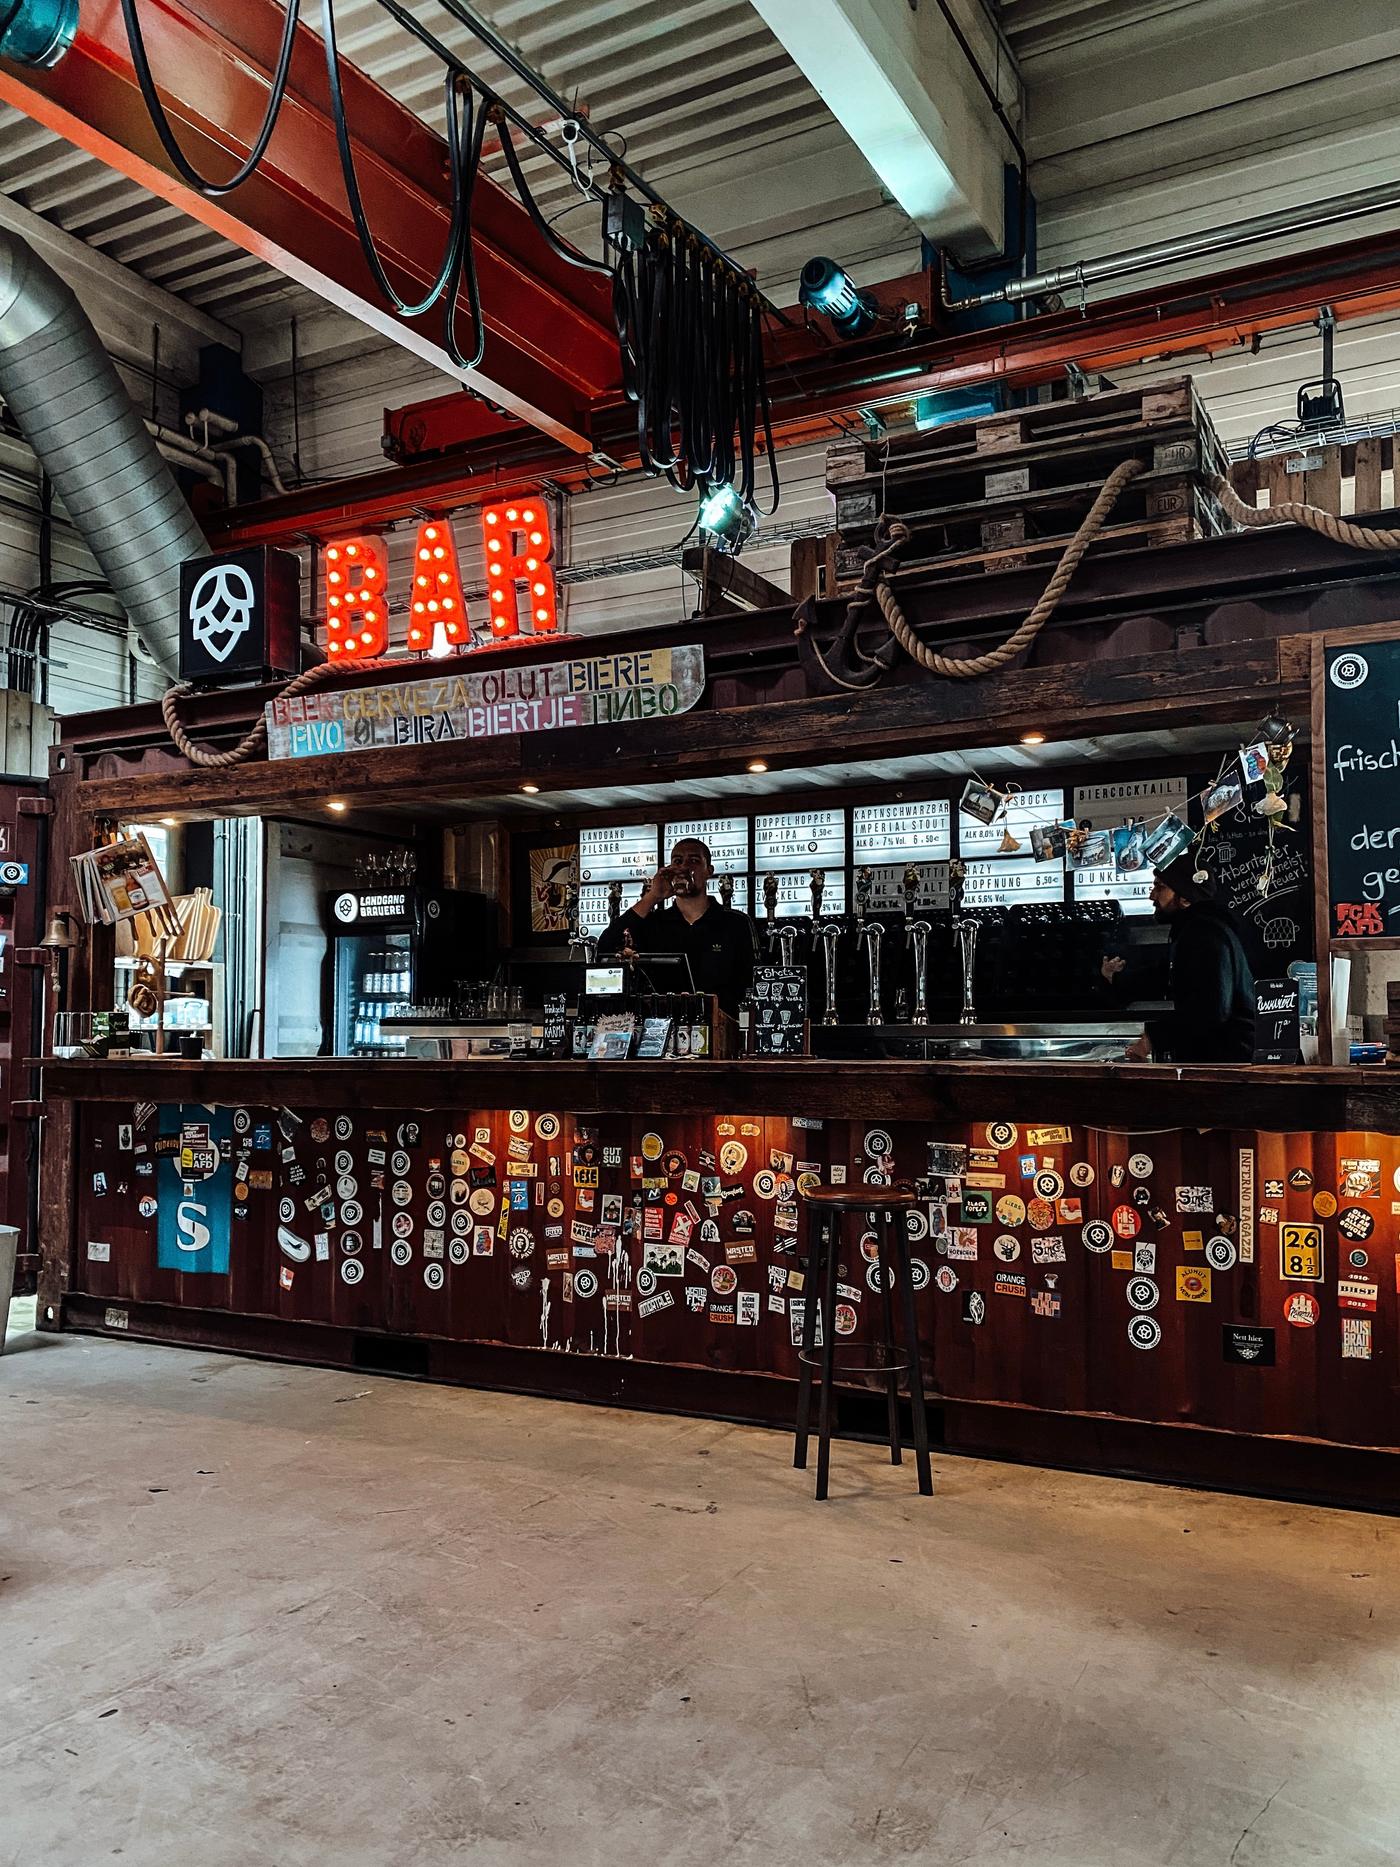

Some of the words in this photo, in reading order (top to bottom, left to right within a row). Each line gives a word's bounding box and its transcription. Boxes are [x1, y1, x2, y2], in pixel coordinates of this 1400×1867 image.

[326, 496, 558, 661] BAR
[272, 694, 335, 724] BEER
[342, 678, 471, 720] CERVEZA
[481, 667, 554, 704] OLUT
[592, 683, 680, 726] ПИВО
[291, 721, 343, 754] PIVO
[393, 711, 456, 745] BIRA
[466, 695, 577, 738] BIERTJE
[757, 818, 791, 828] DOPPEL
[795, 813, 831, 824] HOPPER
[668, 821, 732, 834] GOLDGRAEBER
[855, 821, 906, 834] IMPERIAL
[912, 819, 945, 830] STOUT
[582, 830, 625, 841] LANDGANG
[812, 828, 832, 837] 6,50€
[965, 830, 979, 838] ALK
[979, 829, 994, 838] 8,0%
[582, 843, 619, 853] PILSNER
[965, 864, 991, 875] HAZY
[1218, 844, 1289, 884] Abenteer
[965, 878, 1021, 889] HOPFNUNG
[1036, 876, 1058, 886] 6,50€
[1079, 872, 1128, 883] DUNKEL
[1133, 887, 1146, 895] ALK
[360, 895, 405, 906] LANDGANG
[360, 905, 405, 917] BRAUEREI
[1336, 902, 1380, 920] FCK
[580, 913, 607, 922] LAGER
[1336, 918, 1384, 936] AFD
[544, 1024, 565, 1038] KARMA
[193, 1151, 213, 1161] FCK
[603, 1147, 622, 1155] GUT
[193, 1160, 213, 1169] AFD
[603, 1155, 620, 1164] SUD
[1242, 1152, 1252, 1201] INFERNO
[1260, 1206, 1279, 1217] FCK
[1353, 1209, 1371, 1221] OLAF
[1259, 1214, 1278, 1223] AFD
[1347, 1212, 1359, 1222] IST
[1359, 1219, 1370, 1228] AN
[1340, 1220, 1367, 1239] SCHOLZ
[1345, 1218, 1367, 1232] ALLEM
[1241, 1205, 1252, 1259] RAGAZZI
[1286, 1231, 1317, 1249] 2,6
[726, 1246, 754, 1255] WASTED
[996, 1274, 1026, 1285] ORANGE
[1181, 1269, 1206, 1279] ALUHUT
[996, 1284, 1025, 1294] CRUSH
[710, 1304, 734, 1313] ORANGE
[710, 1313, 734, 1322] CRUSH
[1343, 1319, 1369, 1334] HAUS
[1233, 1333, 1247, 1341] Neu
[1248, 1334, 1264, 1342] hier.
[1343, 1333, 1369, 1347] BRAU
